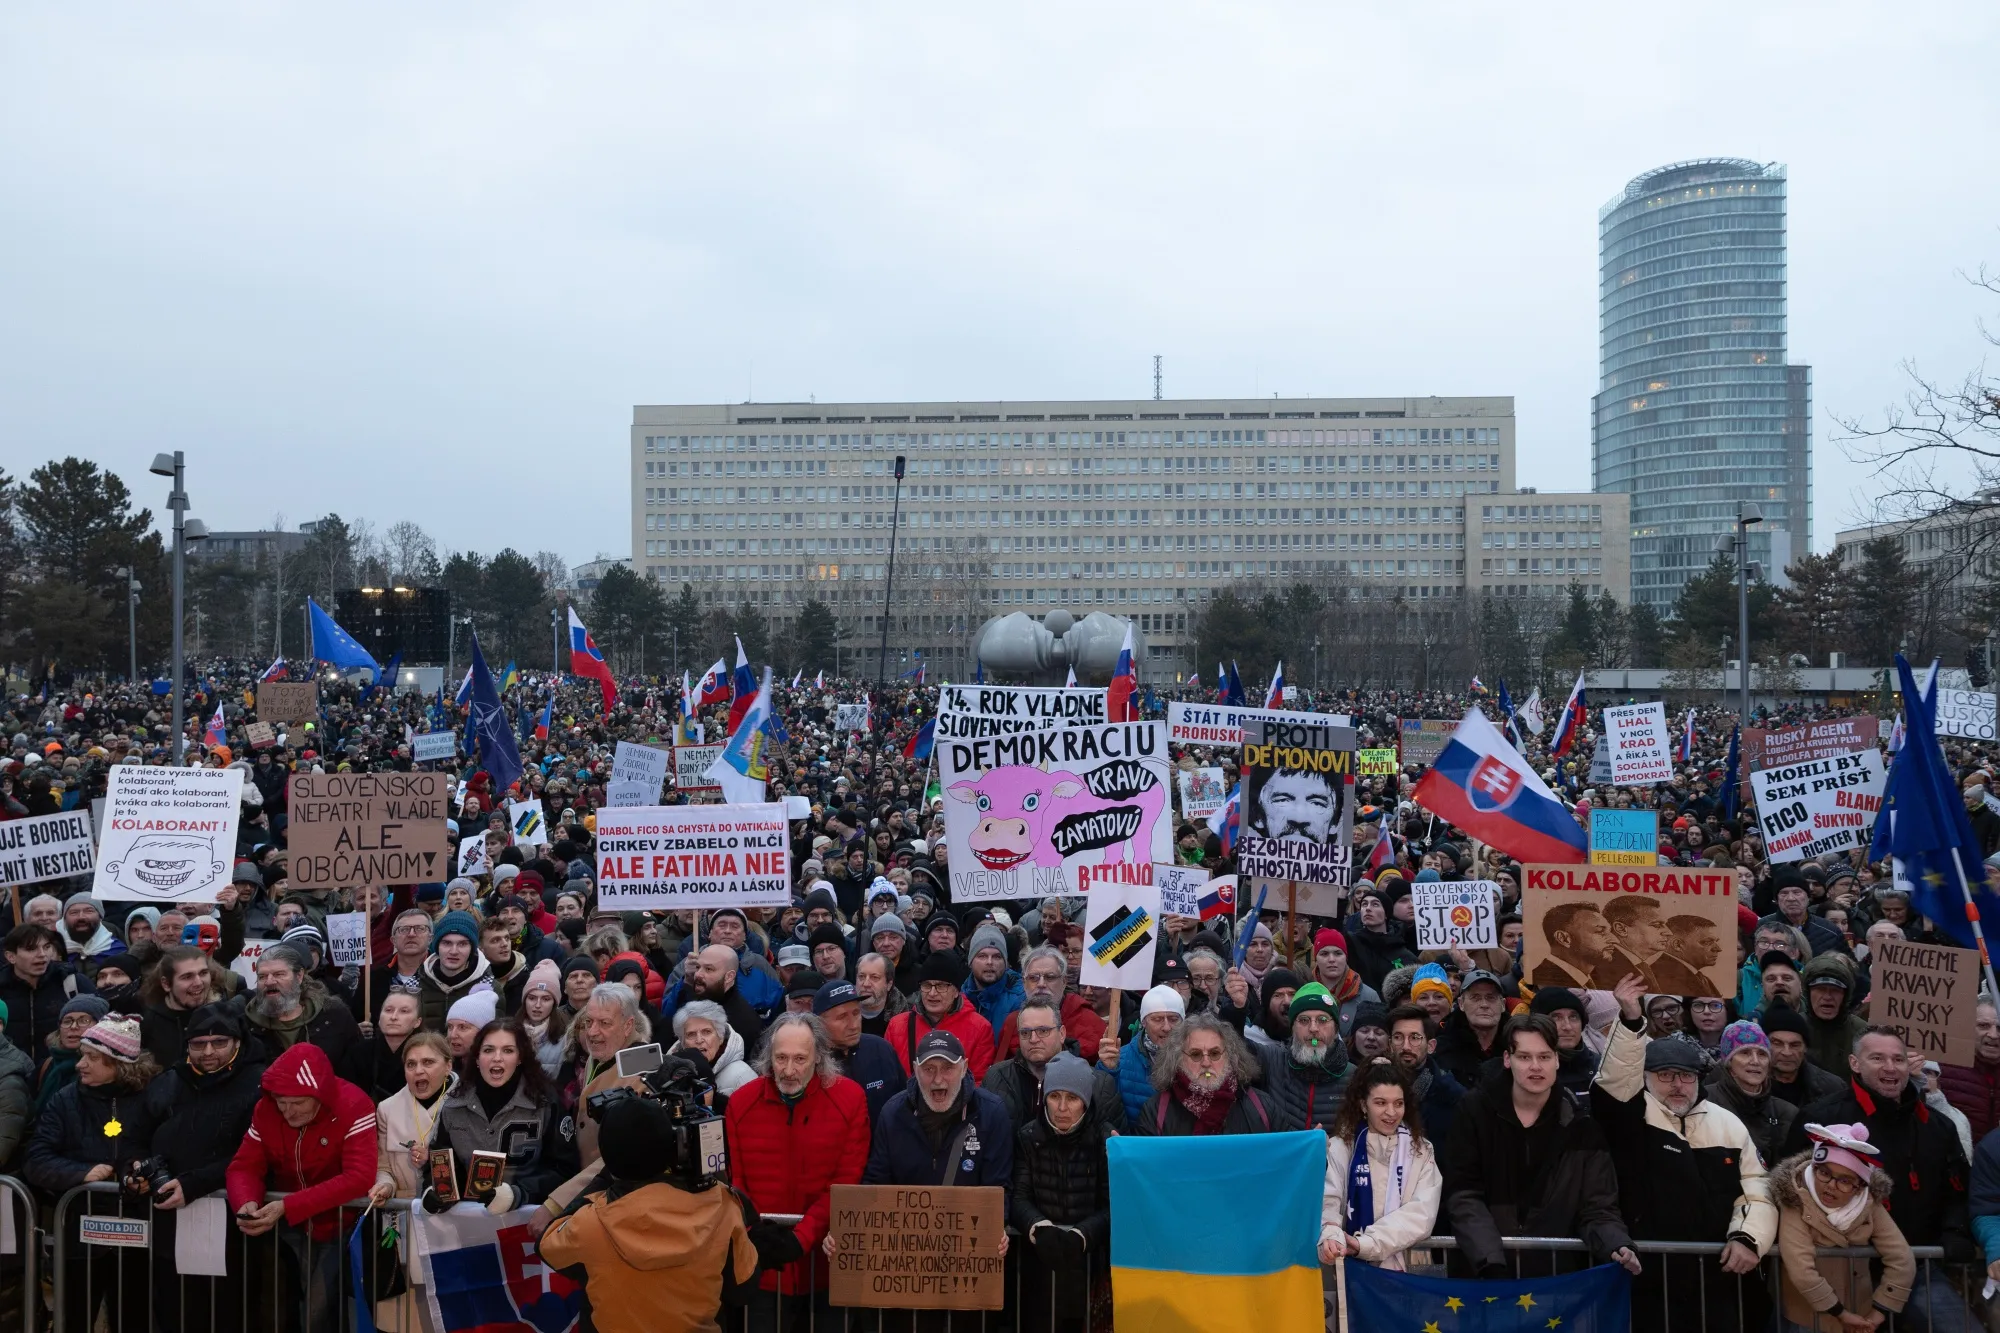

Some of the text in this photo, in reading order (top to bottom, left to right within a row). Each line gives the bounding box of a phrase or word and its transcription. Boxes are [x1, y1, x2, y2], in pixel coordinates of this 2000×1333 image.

[272, 686, 306, 697] TOTO
[1936, 690, 1995, 706] ICO=
[946, 688, 1104, 718] 14. ROK VLÁDNE
[1610, 706, 1656, 718] PŘES DEN
[1182, 708, 1221, 726] ŠTÁT
[1618, 716, 1652, 728] LHAL
[1262, 722, 1330, 748] PROTI
[1630, 729, 1653, 738] NOCI
[1765, 722, 1854, 746] RUSKÝ AGENT
[952, 724, 1156, 773] DEMOKRACIU
[1620, 738, 1656, 749] KRAD
[1766, 735, 1862, 755] LOBUJE ZA KRVAVÝ PLYN
[684, 748, 716, 760] NEMÁM
[1244, 740, 1350, 774] DÉMONOVI
[1766, 747, 1851, 766] U ADOLFA PUTINA
[120, 767, 224, 778] Ak niečo vyzerá ako
[676, 762, 700, 774] JEDINÝ
[1362, 762, 1392, 773] MAFII
[1617, 758, 1666, 772] SOCIÁLNÍ
[1765, 754, 1864, 784] MOHLI BY
[118, 777, 177, 786] kolaborant,
[681, 776, 692, 786] TU
[1087, 764, 1153, 795] KRAVU
[1614, 770, 1670, 782] DEMOKRAT
[1765, 766, 1872, 802] SEM PRÍSŤ
[117, 787, 230, 798] chodí ako kolaborant,
[294, 776, 434, 798] SLOVENSKO
[114, 807, 138, 816] je to
[115, 798, 230, 809] kváka ako kolaborant,
[295, 798, 444, 822] NEPATRÍ VLÁDE,
[112, 819, 219, 832] KOLABORANT
[600, 822, 784, 836] DIABOL FICO SA CHYSTÁ DO VATIKÁNU
[1596, 812, 1623, 827] PÁN
[1764, 802, 1809, 837] FICO
[29, 817, 88, 846] BORDEL
[334, 824, 403, 851] ALE
[1052, 808, 1140, 851] ZAMATOVÚ
[600, 833, 783, 852] CIRKEV ZBABELO MLČÍ
[1596, 831, 1654, 851] PREZIDENT
[1768, 828, 1814, 855] KALIŇÁK
[1801, 829, 1853, 858] RICHTER
[32, 843, 93, 878] NESTAČÍ
[296, 851, 437, 882] OBČANOM!
[600, 852, 785, 879] ALE FATIMA NIE
[1597, 853, 1646, 864] PELLEGRINI
[600, 878, 785, 895] TÁ PRINÁŠA POKOJ A LÁSKU
[1032, 867, 1068, 894] NA
[1078, 860, 1152, 892] BITÚNO
[1527, 870, 1730, 896] KOLABORANTI
[1416, 882, 1488, 894] SLOVENSKO
[1416, 896, 1430, 906] JE
[332, 937, 366, 949] MY SME
[1094, 912, 1150, 960] MIER UKRAJINE
[1420, 927, 1490, 944] RUSKU
[1879, 944, 1958, 974] NECHCEME
[1882, 970, 1956, 1000] KRVAVÝ
[1888, 996, 1954, 1026] RUSKÝ
[85, 1222, 98, 1230] TOI
[100, 1222, 114, 1232] TOI
[123, 1224, 142, 1232] DIXI
[838, 1211, 860, 1228] MY
[864, 1211, 900, 1228] VIEME
[903, 1212, 929, 1230] KTO
[934, 1212, 964, 1230] STE
[840, 1233, 866, 1250] STE
[872, 1228, 900, 1251] PLNÍ
[902, 1230, 962, 1252] NENÁVISTI
[838, 1253, 864, 1271] STE
[873, 1274, 948, 1294] ODSTÚPTE
